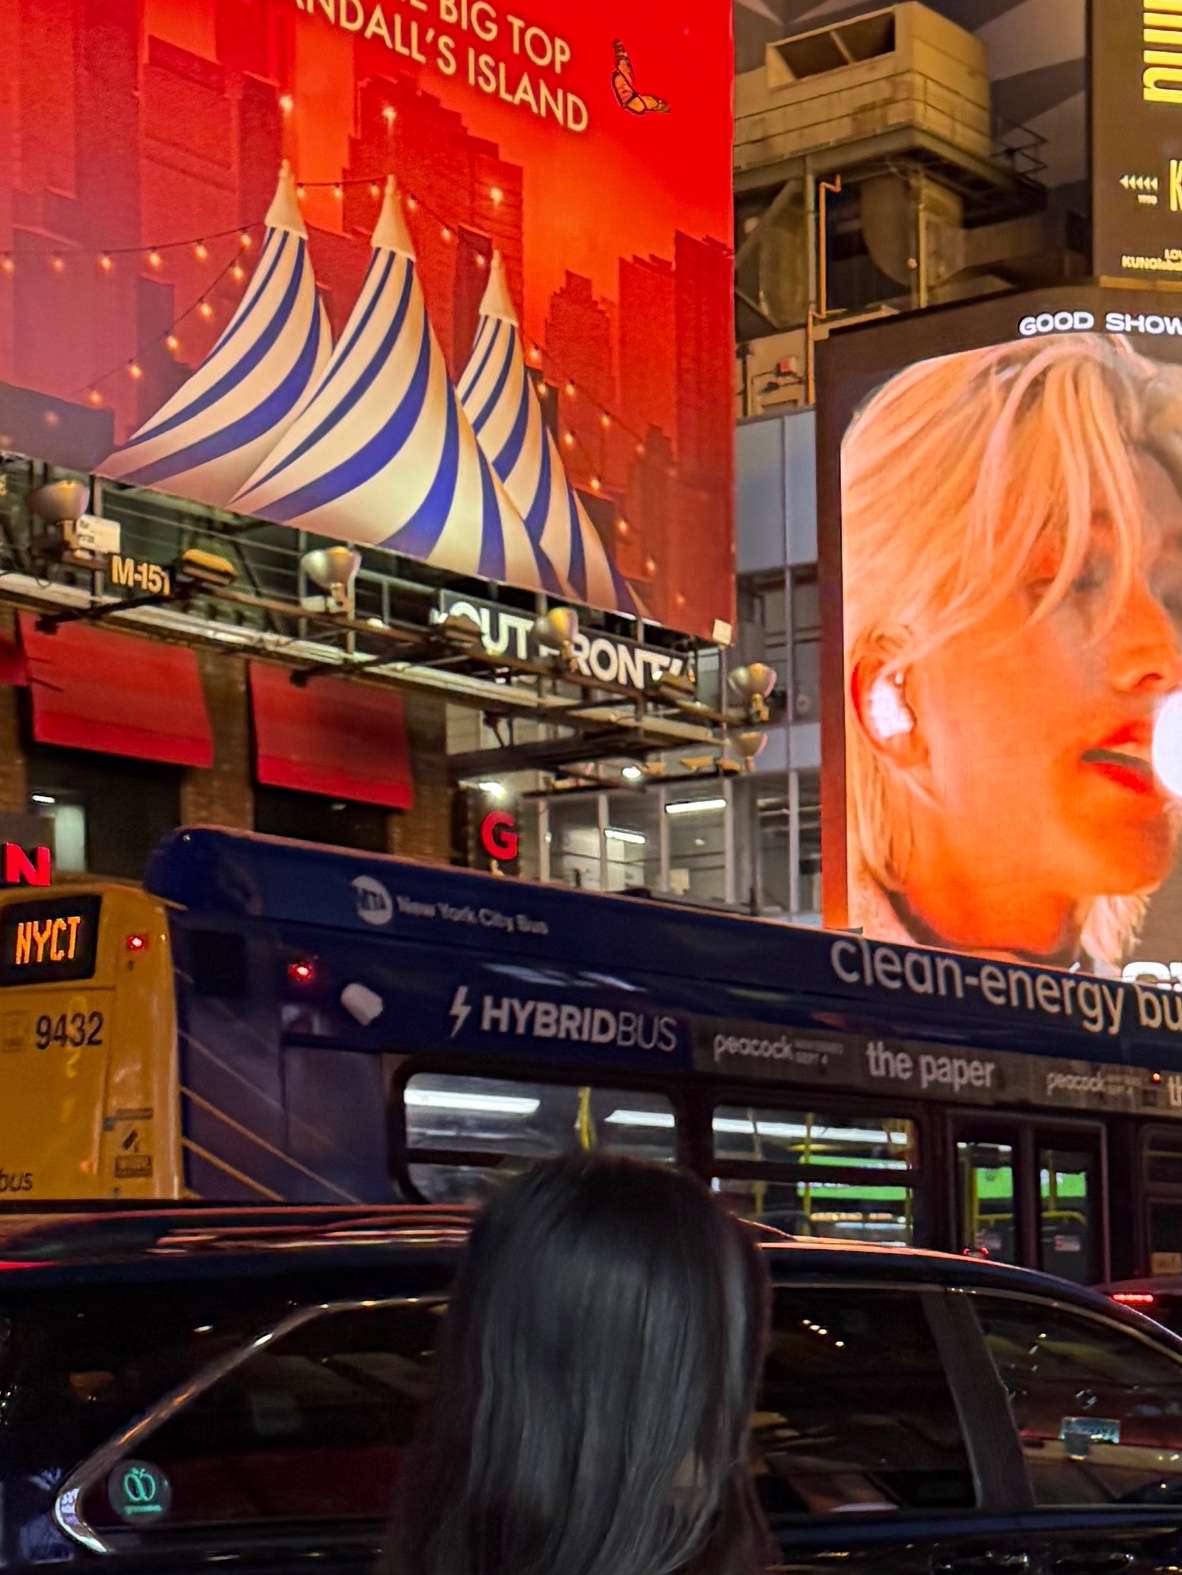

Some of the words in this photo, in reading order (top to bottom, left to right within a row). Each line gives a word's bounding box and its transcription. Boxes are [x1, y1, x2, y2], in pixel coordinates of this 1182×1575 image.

[507, 15, 571, 73] TOP
[469, 48, 589, 132] ISLAND
[1019, 311, 1094, 336] GOOD
[481, 812, 519, 861] G
[5, 842, 51, 887] N
[15, 916, 81, 965] NYCT
[831, 938, 1124, 1035] clean-energy
[35, 1011, 103, 1050] 9432
[713, 1034, 795, 1063] peacock
[866, 1041, 913, 1080] the
[919, 1053, 996, 1092] paper
